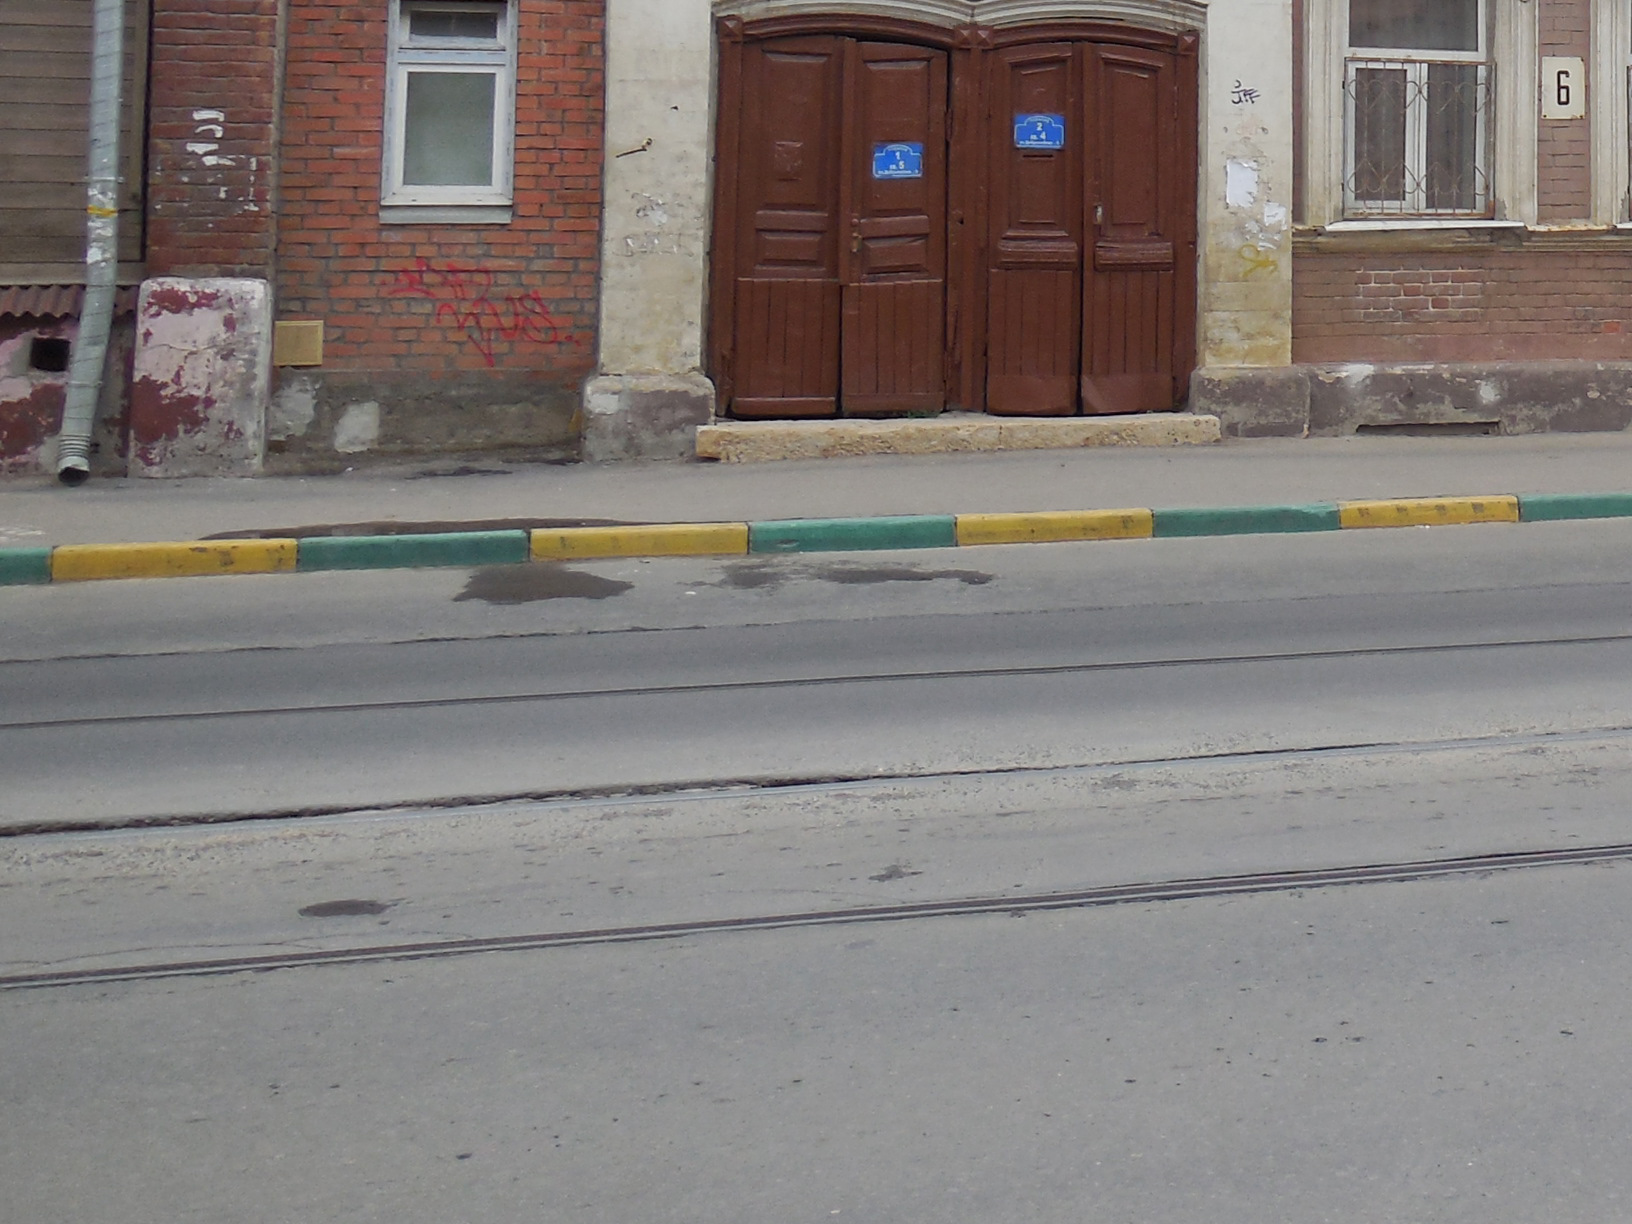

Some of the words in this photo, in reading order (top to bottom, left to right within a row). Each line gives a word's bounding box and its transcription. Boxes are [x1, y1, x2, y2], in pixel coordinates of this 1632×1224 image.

[1557, 70, 1570, 105] 6
[1036, 122, 1043, 131] 2
[1040, 131, 1047, 140] 4
[895, 151, 901, 160] 1
[898, 160, 905, 169] 5
